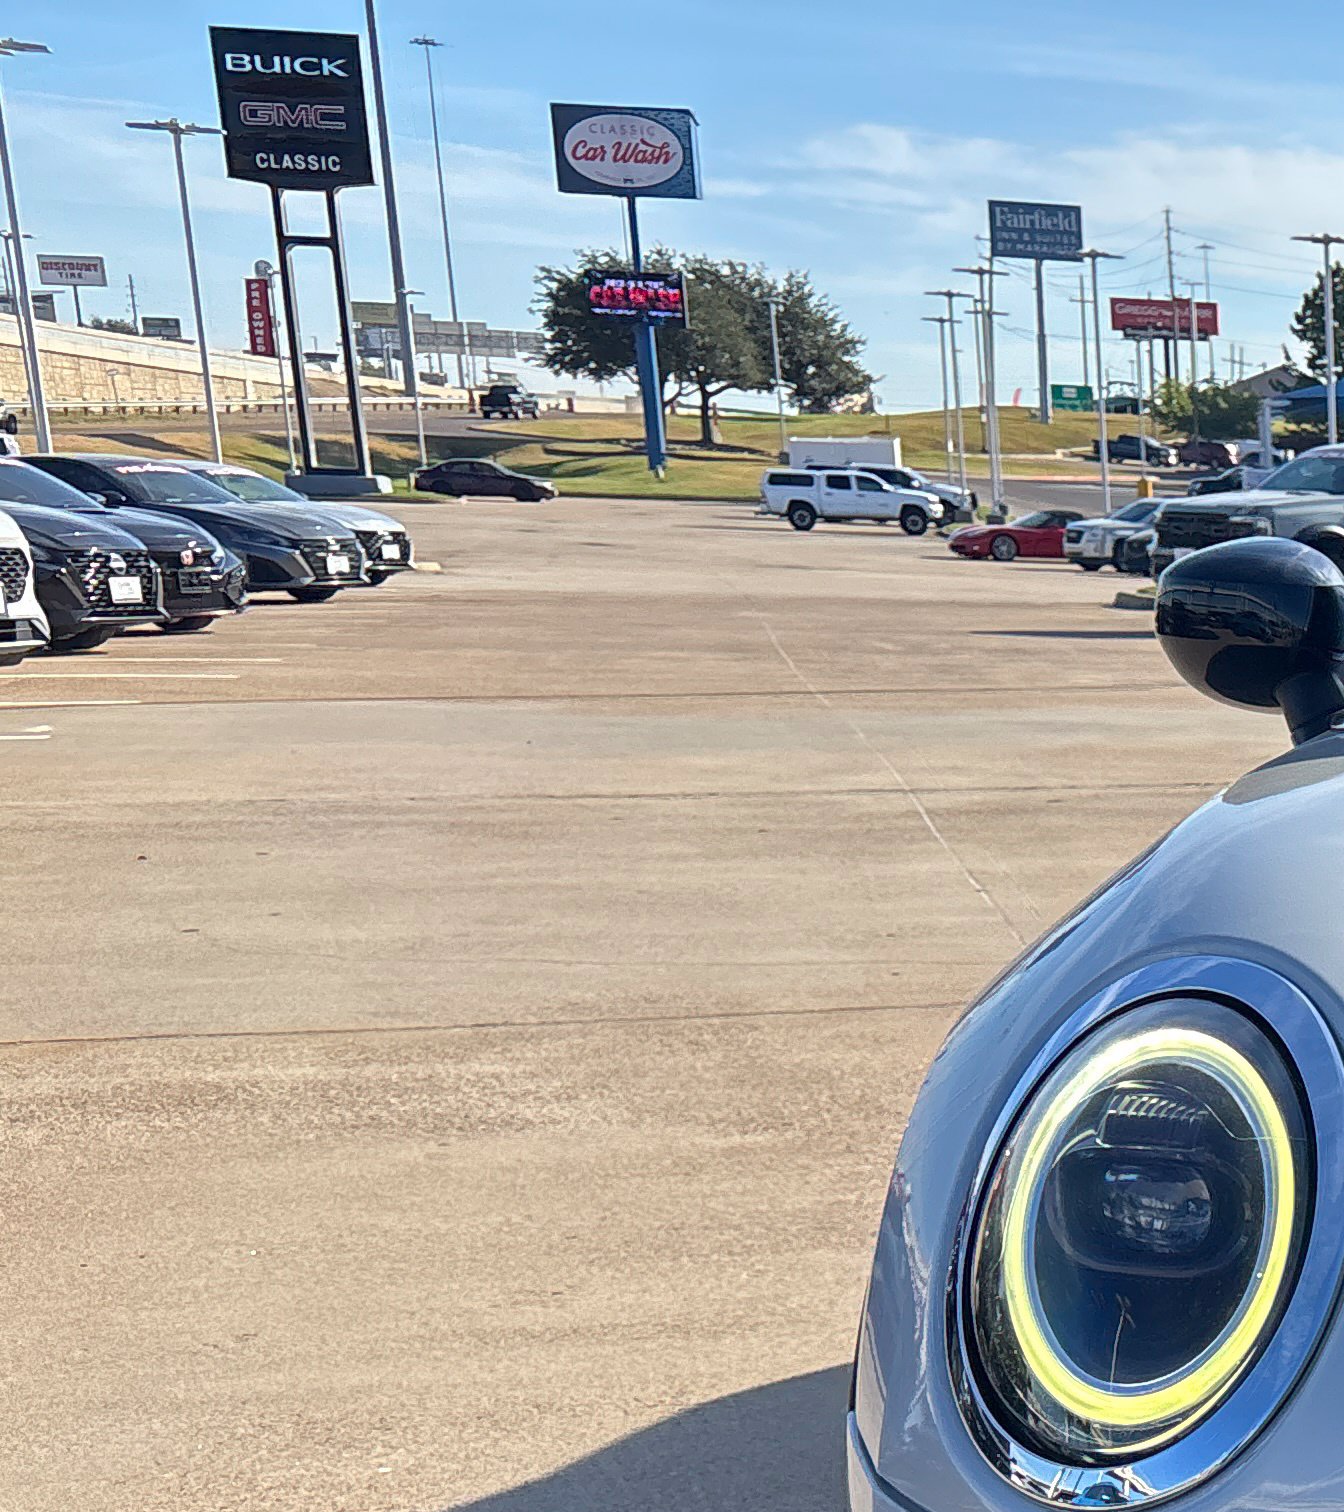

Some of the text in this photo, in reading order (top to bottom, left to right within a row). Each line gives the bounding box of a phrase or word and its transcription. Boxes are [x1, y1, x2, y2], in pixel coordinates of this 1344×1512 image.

[224, 52, 350, 78] BUICK
[239, 101, 347, 130] GMC
[587, 122, 657, 137] CLASSIC
[255, 152, 342, 173] CLASSIC
[571, 138, 678, 165] Car Wash
[994, 206, 1078, 232] Fairfield
[41, 261, 99, 273] DISCOUNT
[57, 271, 84, 280] TIRE
[252, 311, 267, 353] OWNED
